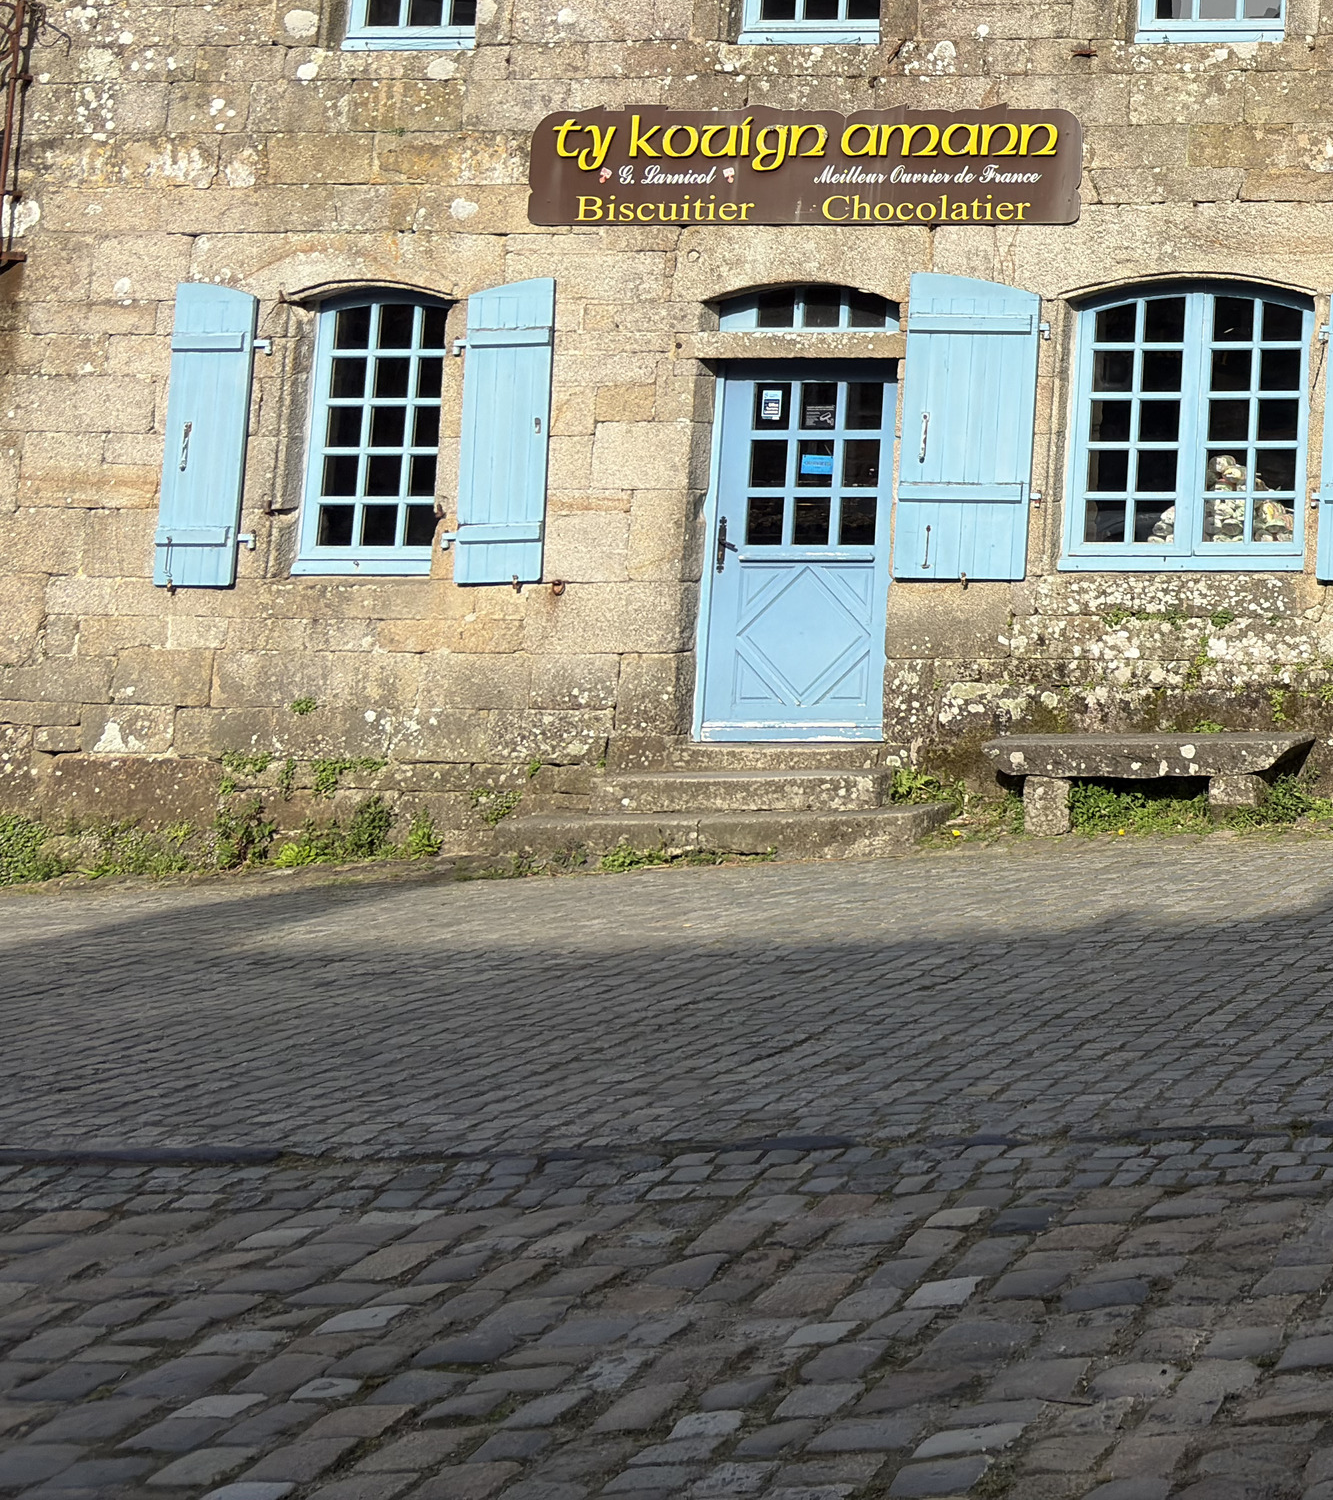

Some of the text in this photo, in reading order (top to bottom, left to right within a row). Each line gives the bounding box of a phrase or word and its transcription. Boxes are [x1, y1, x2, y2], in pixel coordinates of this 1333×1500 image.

[552, 119, 617, 171] ty
[840, 123, 1058, 156] amann
[618, 165, 717, 185] G. Larnicol
[814, 164, 1042, 184] Meilleur Ouvrier de France
[574, 194, 755, 221] Biscuitier
[821, 194, 1031, 221] Chocolatier
